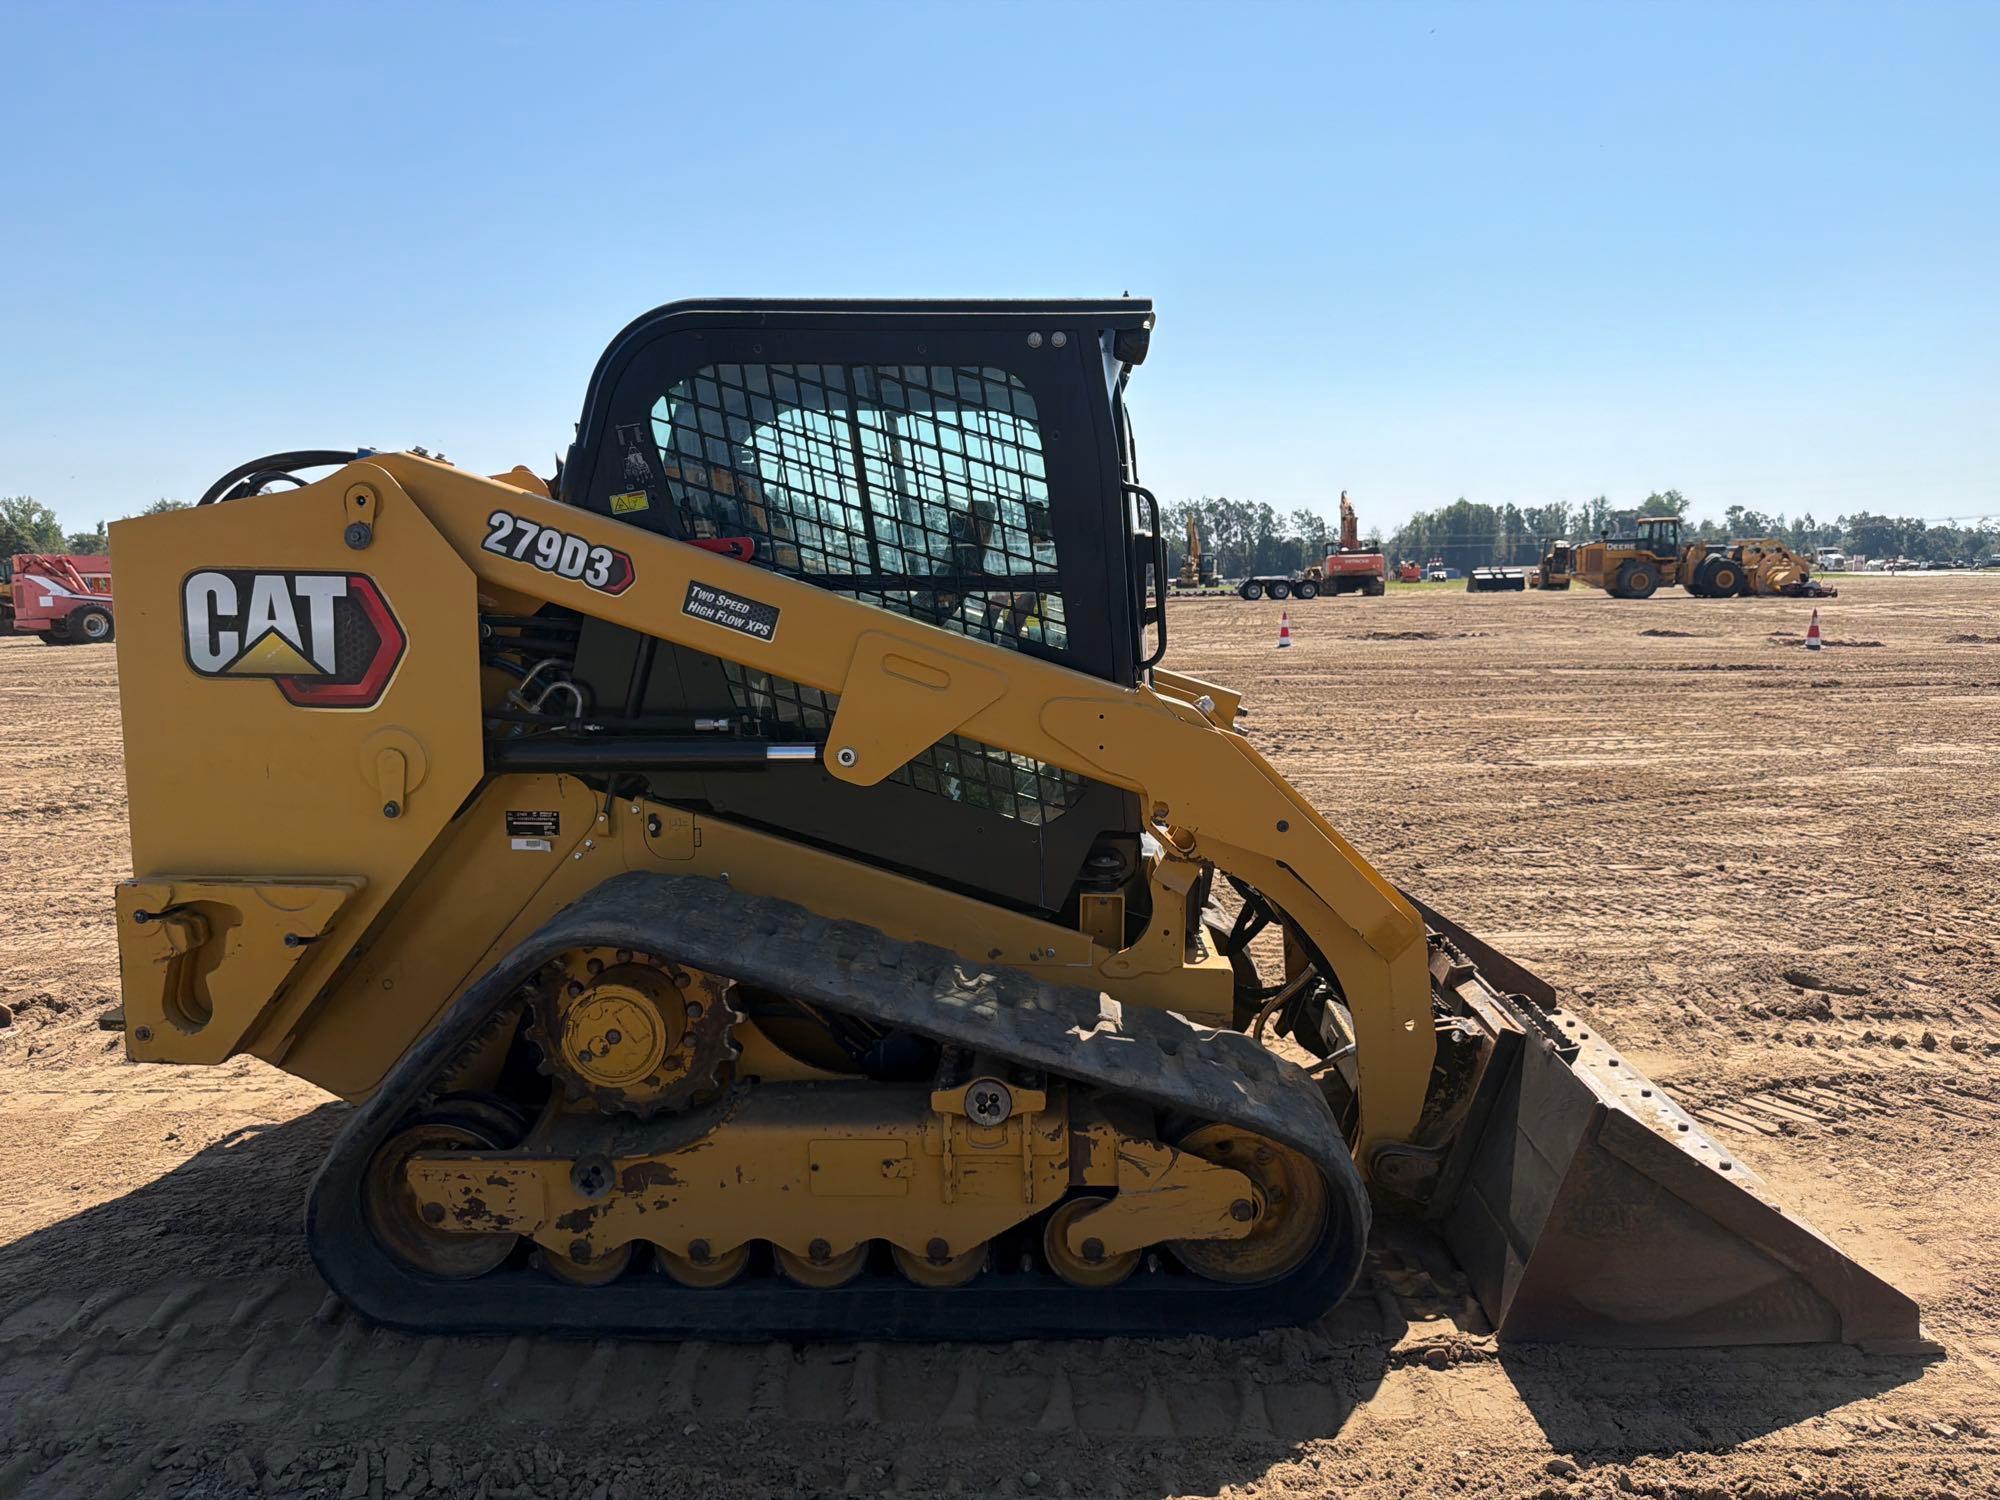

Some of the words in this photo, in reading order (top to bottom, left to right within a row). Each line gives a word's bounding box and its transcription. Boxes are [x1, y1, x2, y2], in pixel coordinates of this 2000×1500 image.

[484, 512, 613, 586] 279D3
[186, 572, 347, 675] CAT
[745, 619, 771, 636] XPS
